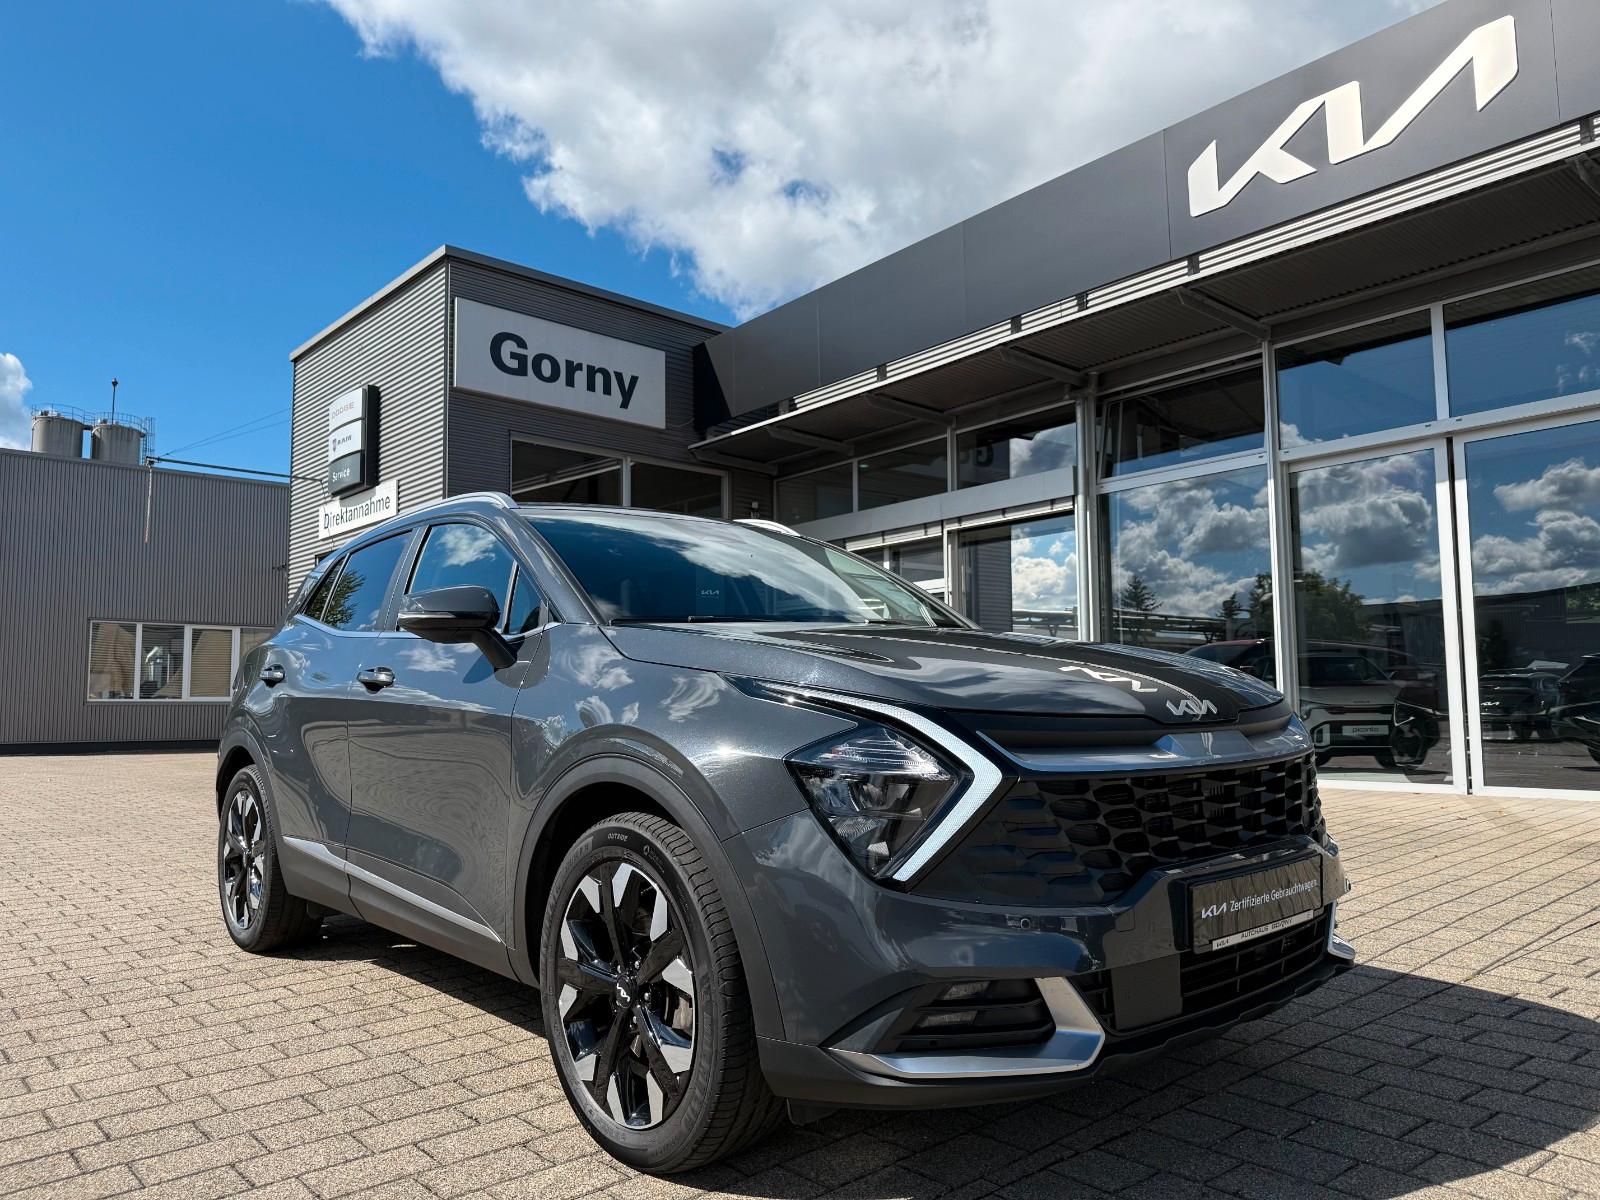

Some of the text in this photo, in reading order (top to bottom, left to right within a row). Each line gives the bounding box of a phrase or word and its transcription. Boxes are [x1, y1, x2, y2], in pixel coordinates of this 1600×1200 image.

[1187, 14, 1518, 217] KIA
[489, 331, 639, 409] Gorny
[331, 402, 354, 419] DODGE
[332, 468, 350, 482] Service
[324, 496, 390, 529] Direktannahme
[1201, 879, 1317, 919] KIA Zertifizierte Gebrauchtwagen
